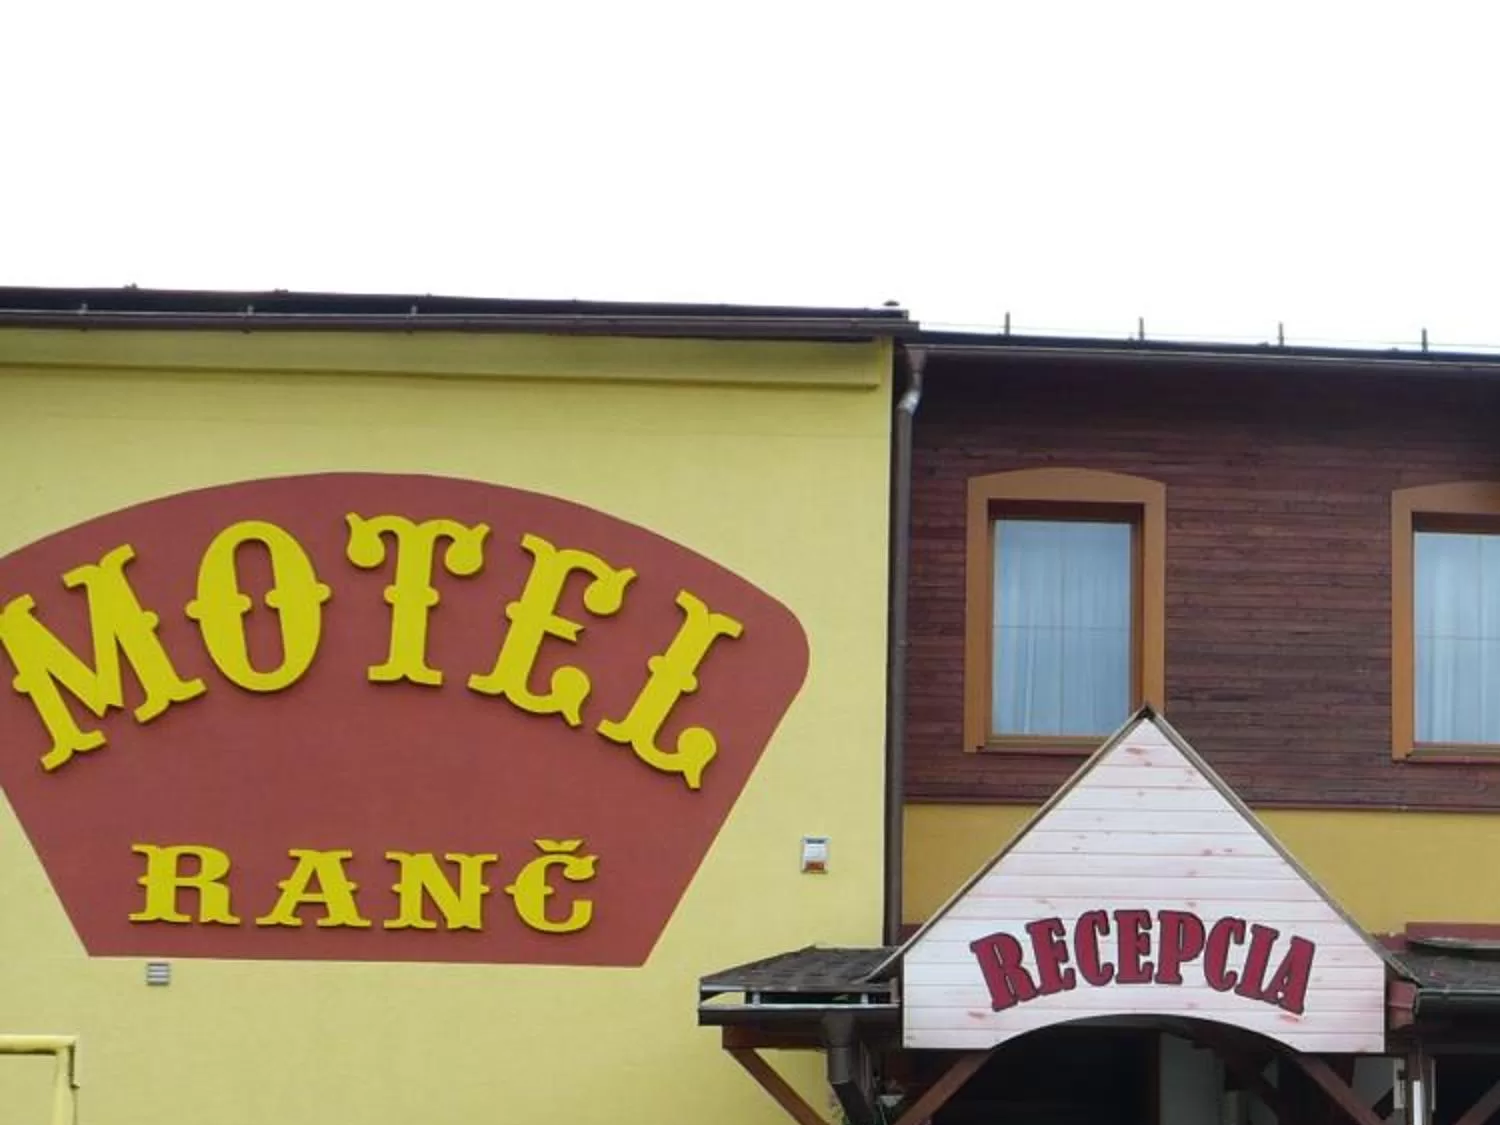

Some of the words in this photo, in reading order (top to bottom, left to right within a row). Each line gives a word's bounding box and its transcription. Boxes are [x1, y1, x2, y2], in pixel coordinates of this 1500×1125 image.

[0, 511, 743, 789] MOTEL
[128, 838, 598, 933] RANČ
[970, 909, 1316, 1015] RECEPCIA
